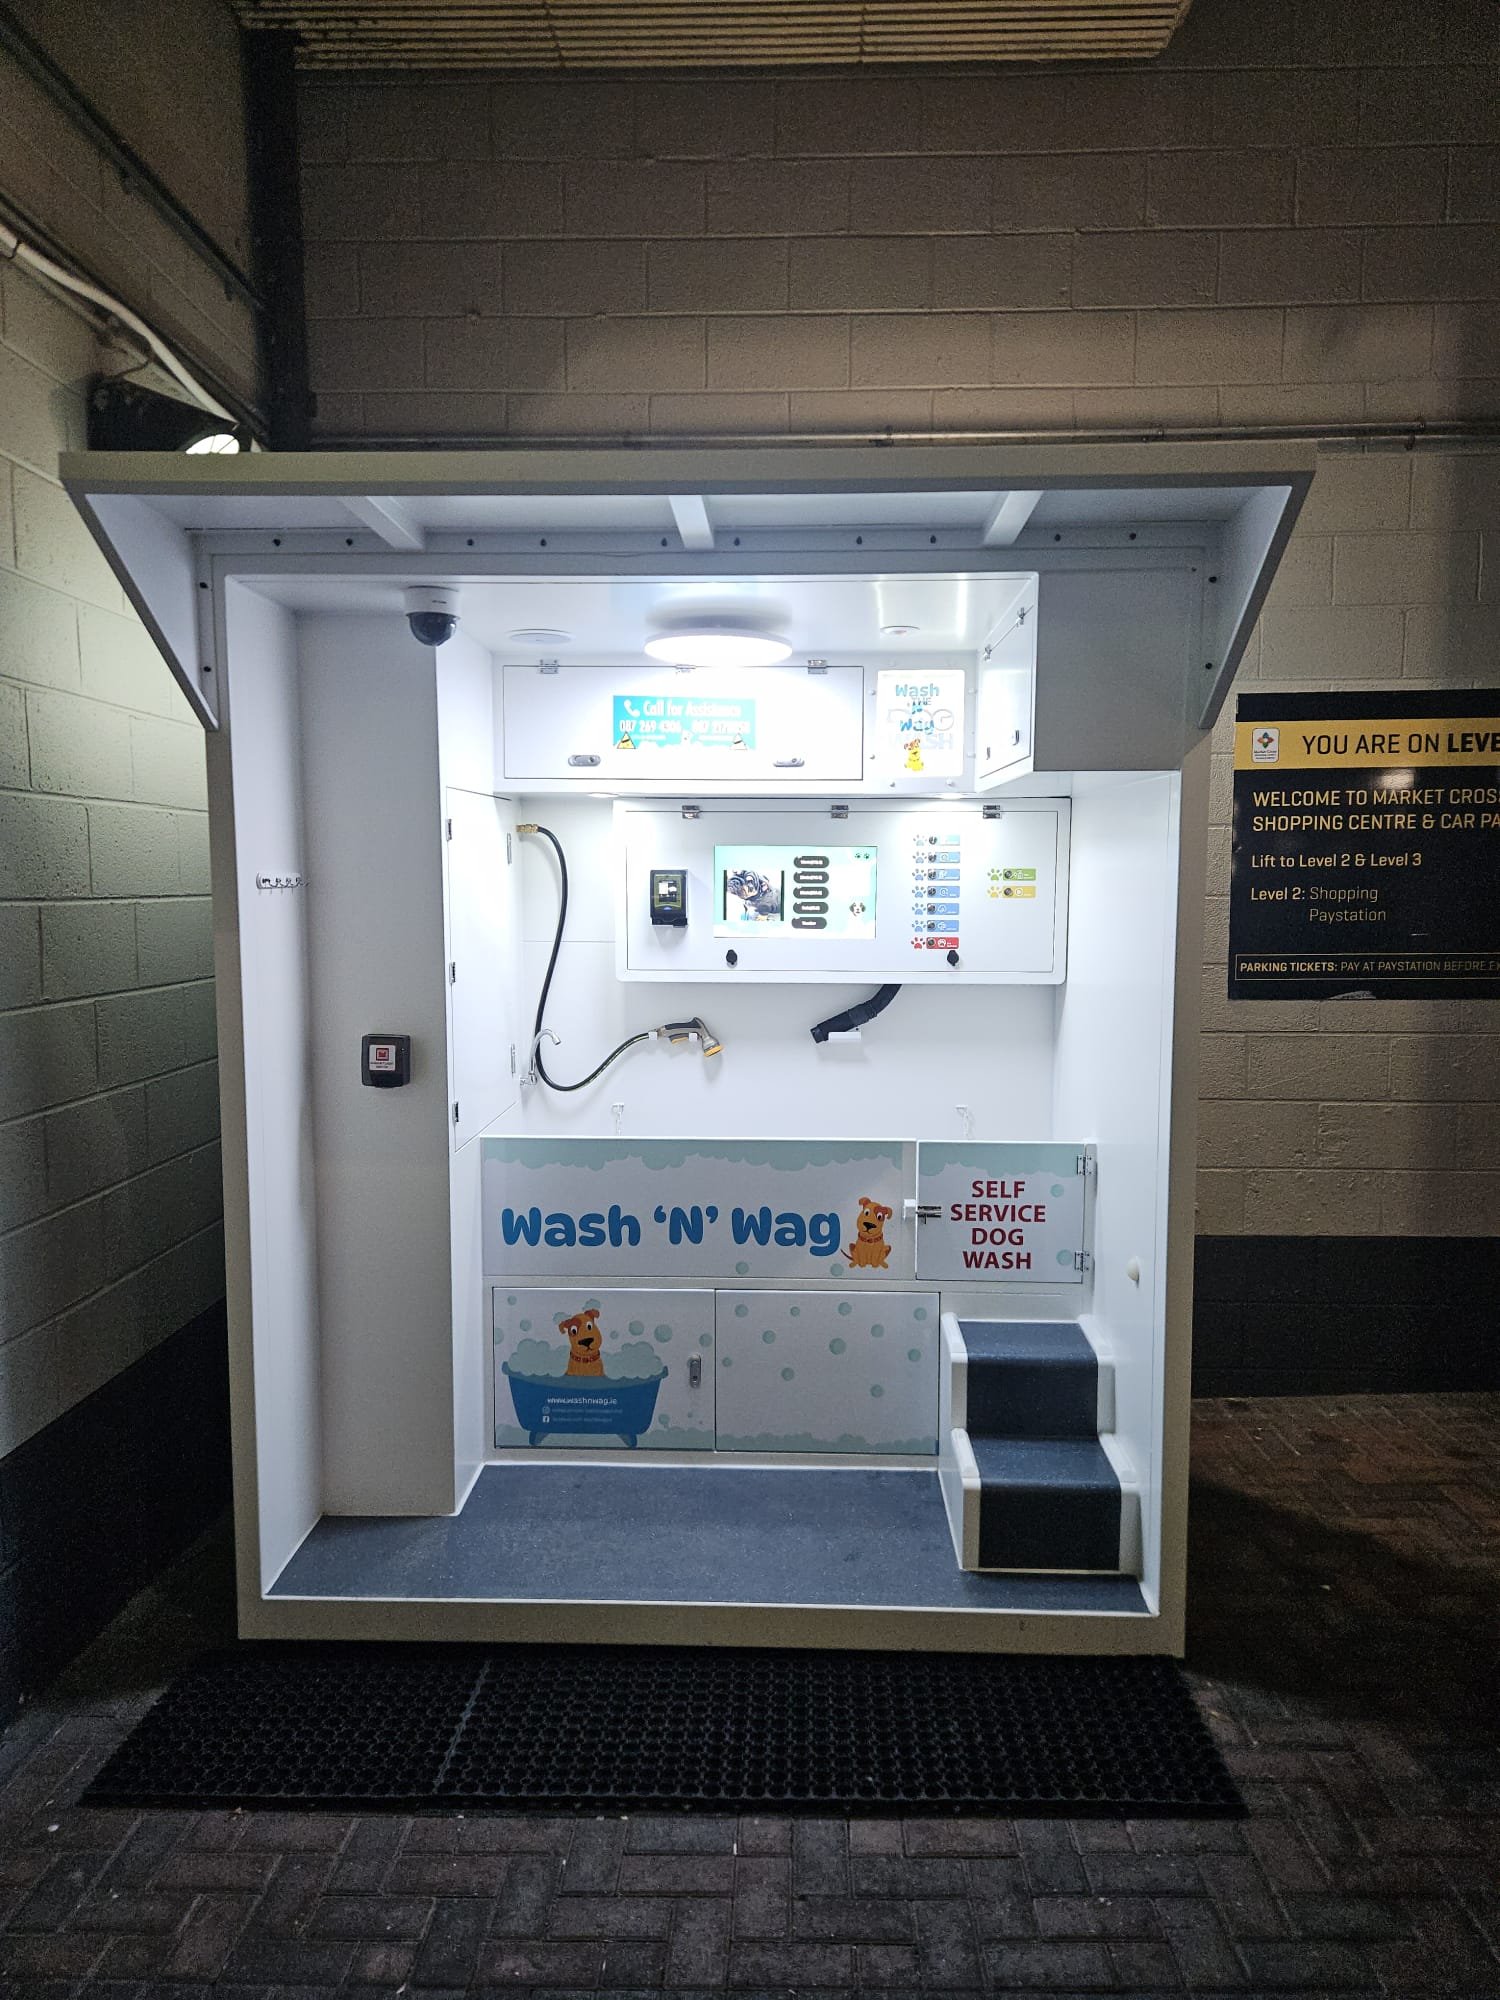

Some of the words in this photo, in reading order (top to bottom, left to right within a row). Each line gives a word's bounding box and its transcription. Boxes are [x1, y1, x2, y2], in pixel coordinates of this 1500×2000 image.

[895, 683, 940, 697] Wash
[643, 700, 665, 717] Call
[620, 720, 635, 733] 087
[1302, 735, 1348, 754] YOU
[1356, 734, 1400, 754] ARE
[1408, 733, 1440, 753] ON
[1447, 732, 1500, 753] LEVE
[1253, 790, 1340, 807] WELCOME
[1346, 790, 1367, 806] TO
[1374, 788, 1445, 805] MARKET
[1449, 788, 1500, 804] CROS
[1253, 815, 1343, 832] SHOPPING
[1348, 814, 1417, 830] CENTRE
[1422, 813, 1437, 829] &
[1441, 813, 1475, 829] CAR
[1480, 813, 1500, 829] PA
[1251, 854, 1276, 868] Lift
[1280, 854, 1295, 868] to
[1299, 854, 1337, 867] Level
[1341, 853, 1350, 867] 2
[1355, 853, 1366, 867] &
[1370, 852, 1408, 867] Level
[1412, 853, 1422, 866] 3
[1251, 887, 1288, 900] Level
[1292, 887, 1306, 900] 2:
[1309, 886, 1378, 903] Shopping
[1309, 908, 1387, 925] Paystation
[1240, 962, 1288, 972] PARKING
[1290, 962, 1338, 972] TICKETS:
[1340, 961, 1359, 971] PAY
[1362, 961, 1375, 971] AT
[1378, 960, 1440, 971] PAYSTATION
[1444, 960, 1487, 971] BEFORE
[971, 1180, 1025, 1198] SELF
[950, 1203, 1046, 1222] SERVICE
[502, 1204, 641, 1247] Wash
[731, 1206, 841, 1257] Wag
[971, 1227, 1024, 1246] DOG
[962, 1250, 1032, 1269] WASH
